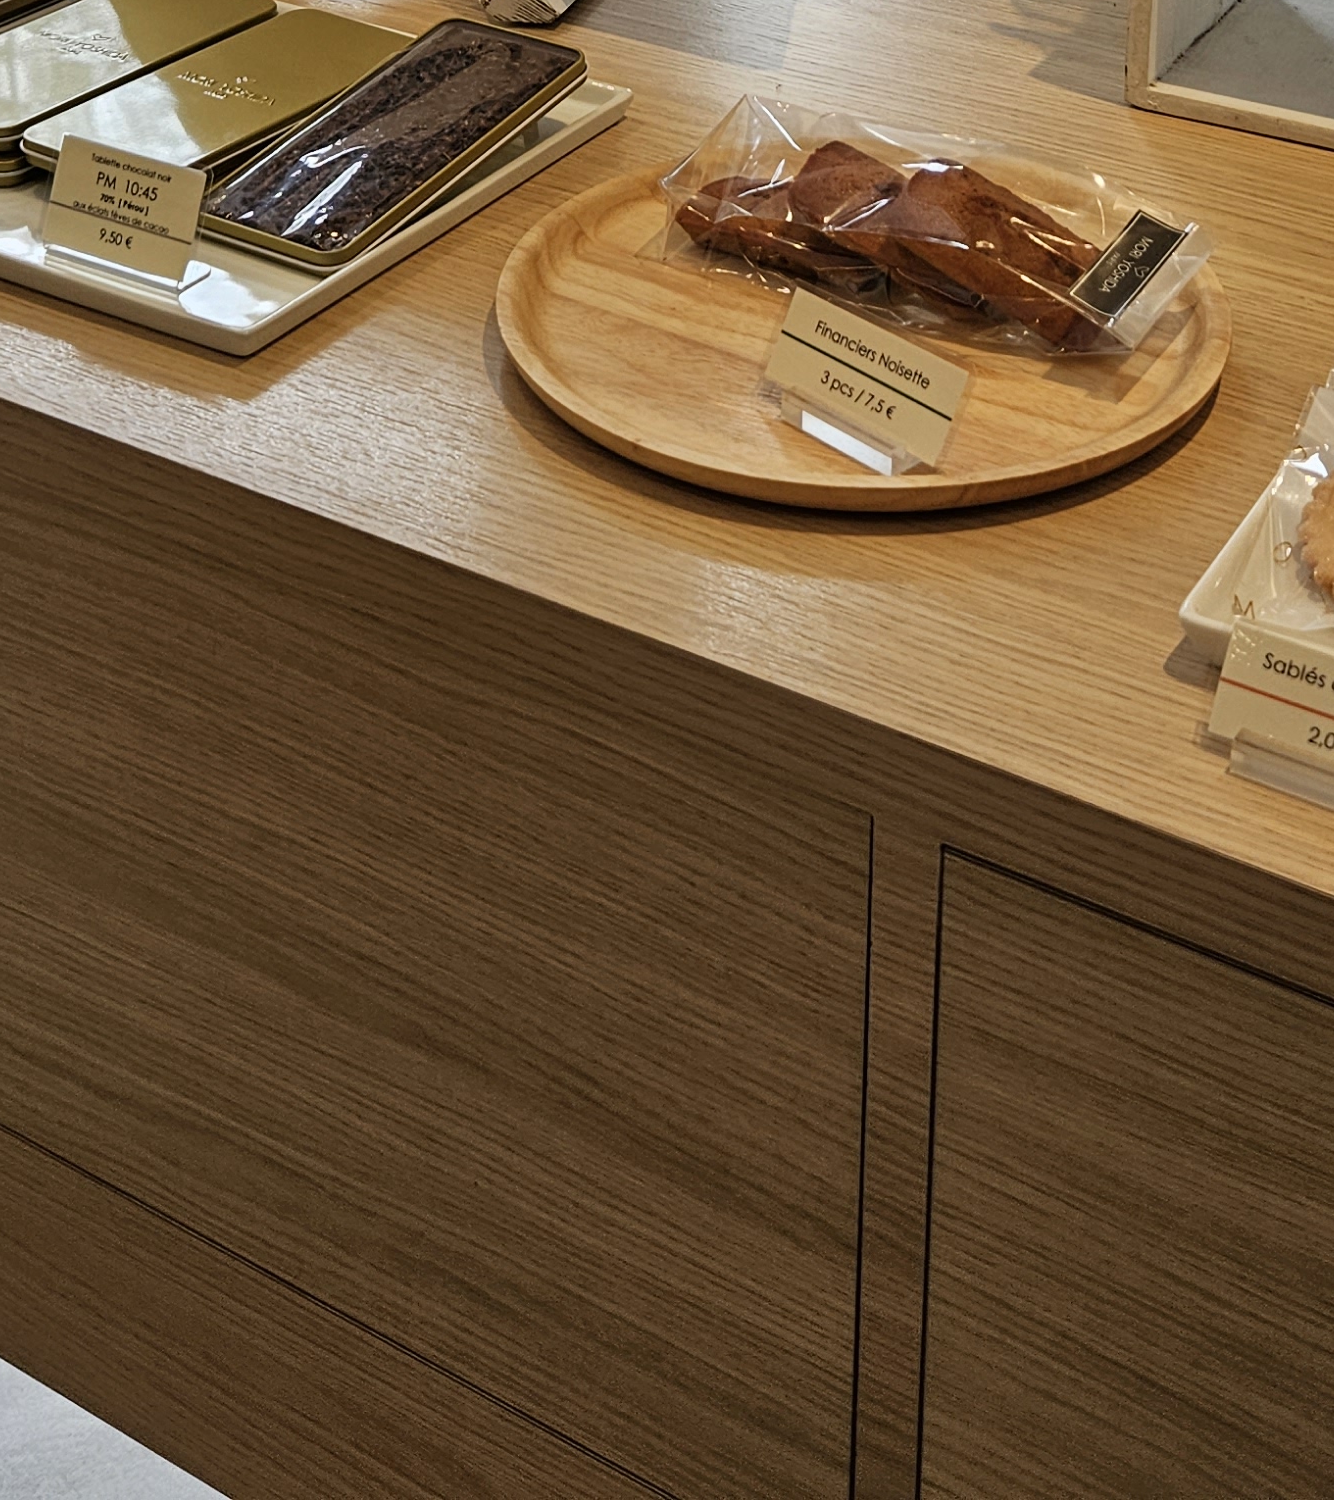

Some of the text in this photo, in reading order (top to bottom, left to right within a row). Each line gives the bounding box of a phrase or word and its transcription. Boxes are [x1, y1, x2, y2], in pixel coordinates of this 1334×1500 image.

[91, 152, 121, 169] Tablette
[122, 160, 157, 179] chocolat
[96, 171, 159, 202] PM 10:45
[814, 319, 931, 390] Financiers Noisette
[820, 369, 831, 385] 3
[829, 376, 855, 399] pcs
[864, 393, 886, 414] 7,5
[886, 405, 897, 421] €
[1262, 651, 1327, 689] Sablés
